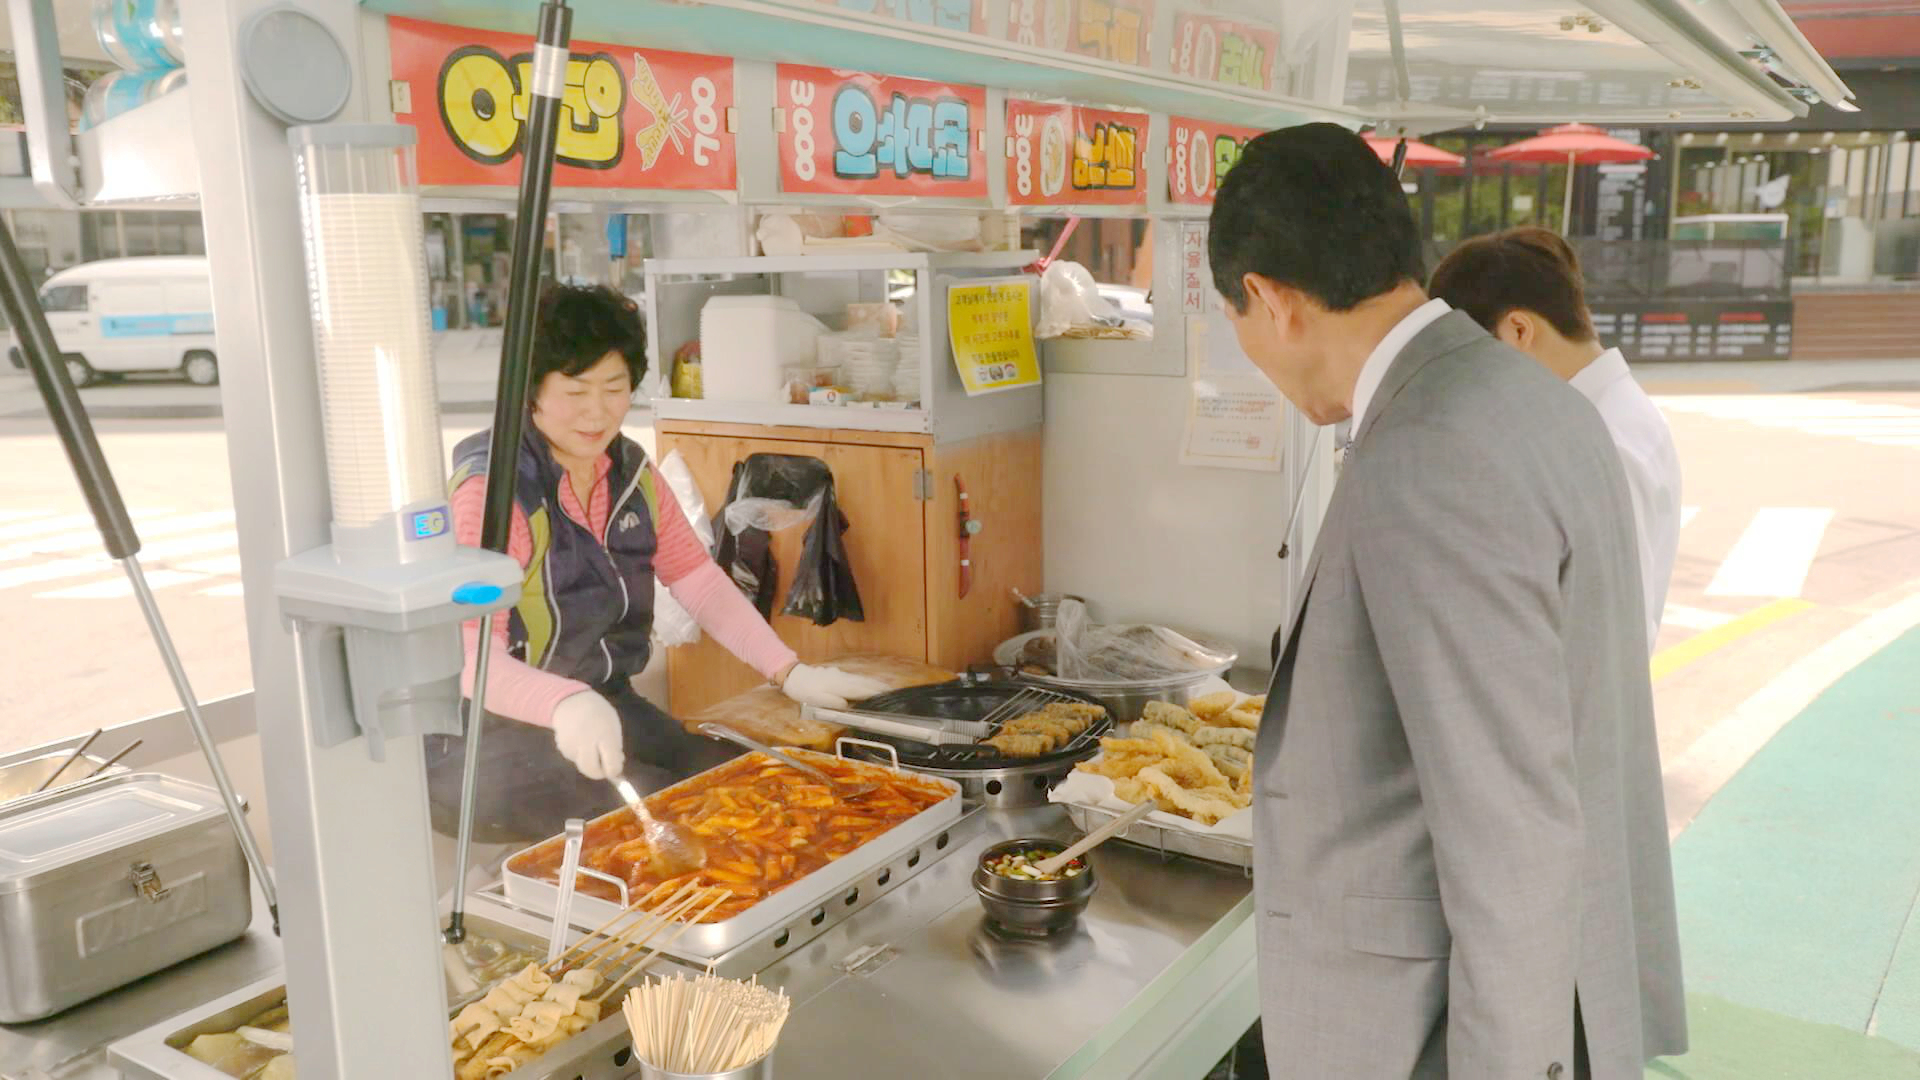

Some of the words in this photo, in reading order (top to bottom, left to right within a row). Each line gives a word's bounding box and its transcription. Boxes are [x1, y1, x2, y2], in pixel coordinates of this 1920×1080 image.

[691, 76, 721, 167] 700
[831, 82, 971, 180] 떡볶이
[1072, 120, 1137, 190] 튀김
[415, 511, 446, 536] EG
